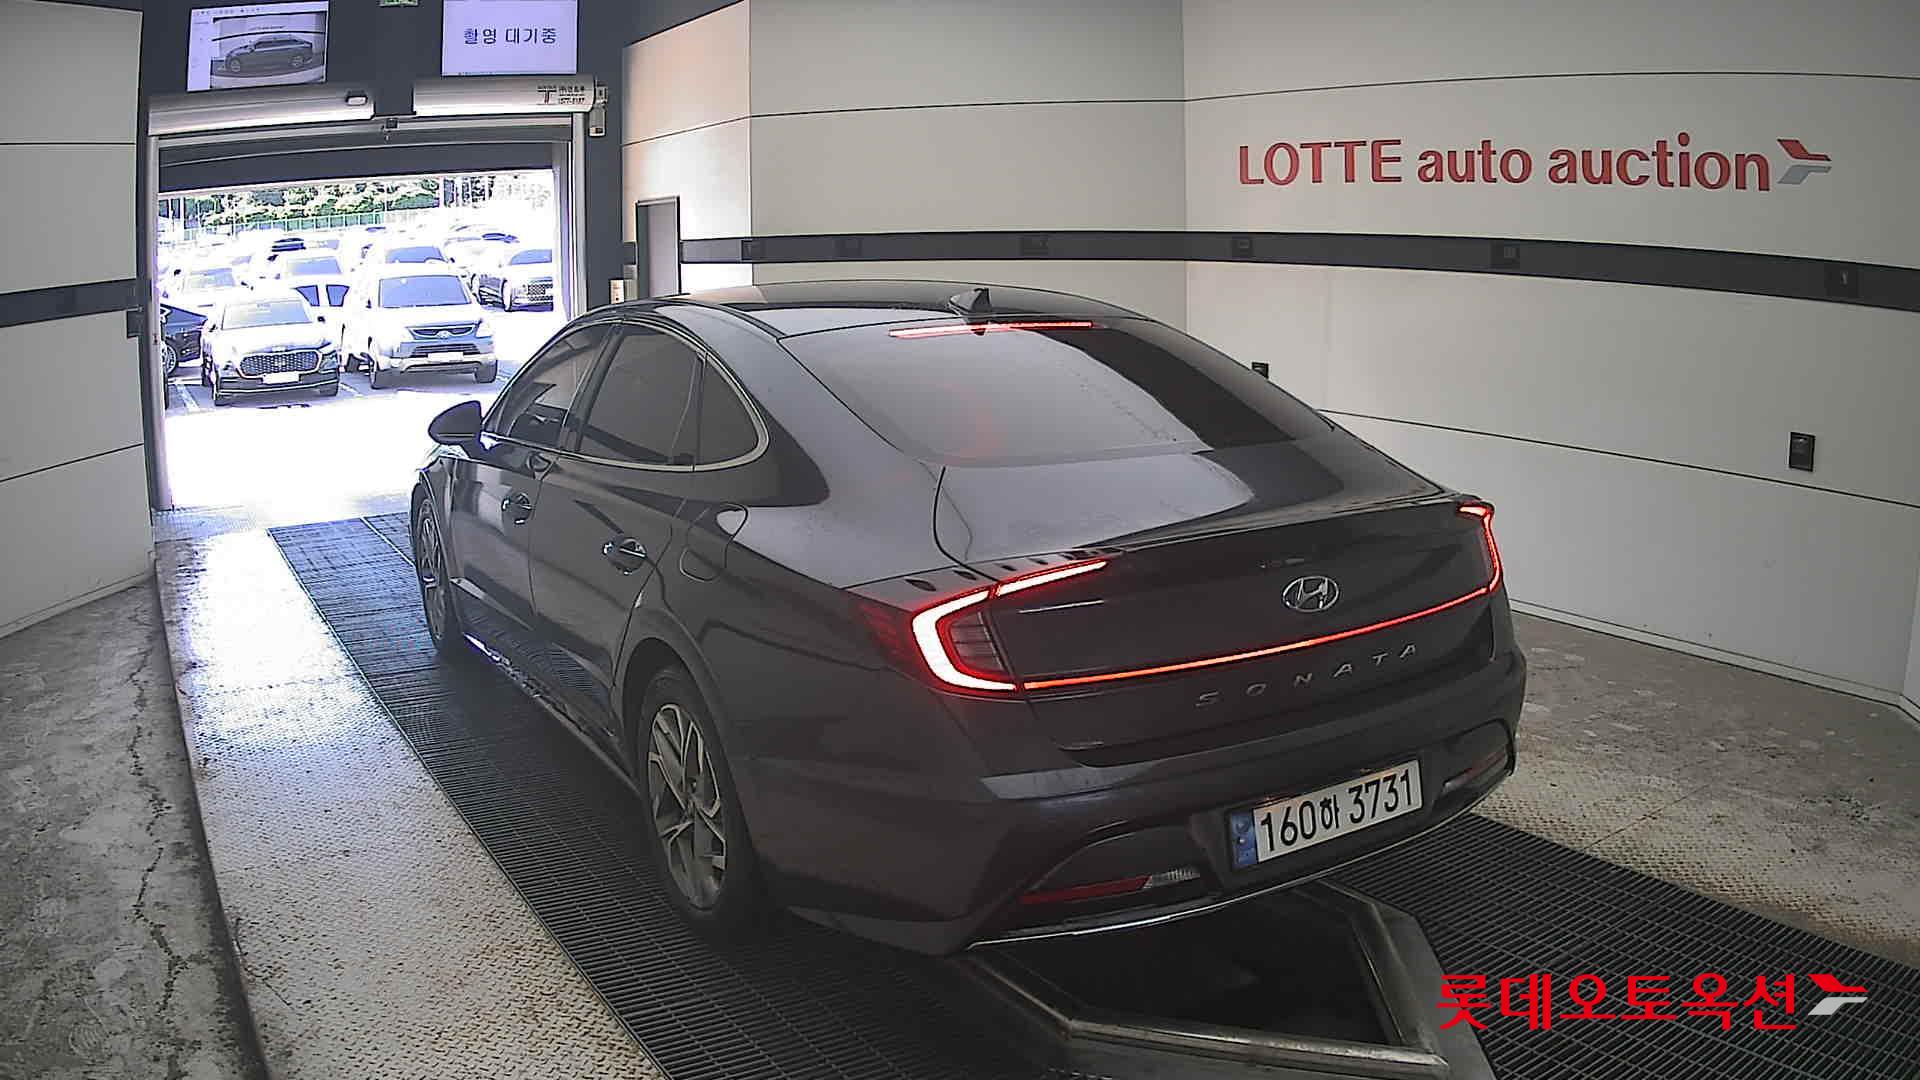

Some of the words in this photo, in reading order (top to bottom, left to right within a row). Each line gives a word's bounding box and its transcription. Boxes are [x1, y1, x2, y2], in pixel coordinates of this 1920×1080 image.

[464, 28, 497, 45] 촬영
[505, 27, 557, 45] 대기중
[1239, 139, 1402, 186] LOTTE
[1417, 140, 1533, 184] auto
[1548, 133, 1770, 191] auction
[1195, 643, 1417, 708] SONATA
[1260, 794, 1340, 852] 160하
[1348, 768, 1412, 824] 3731
